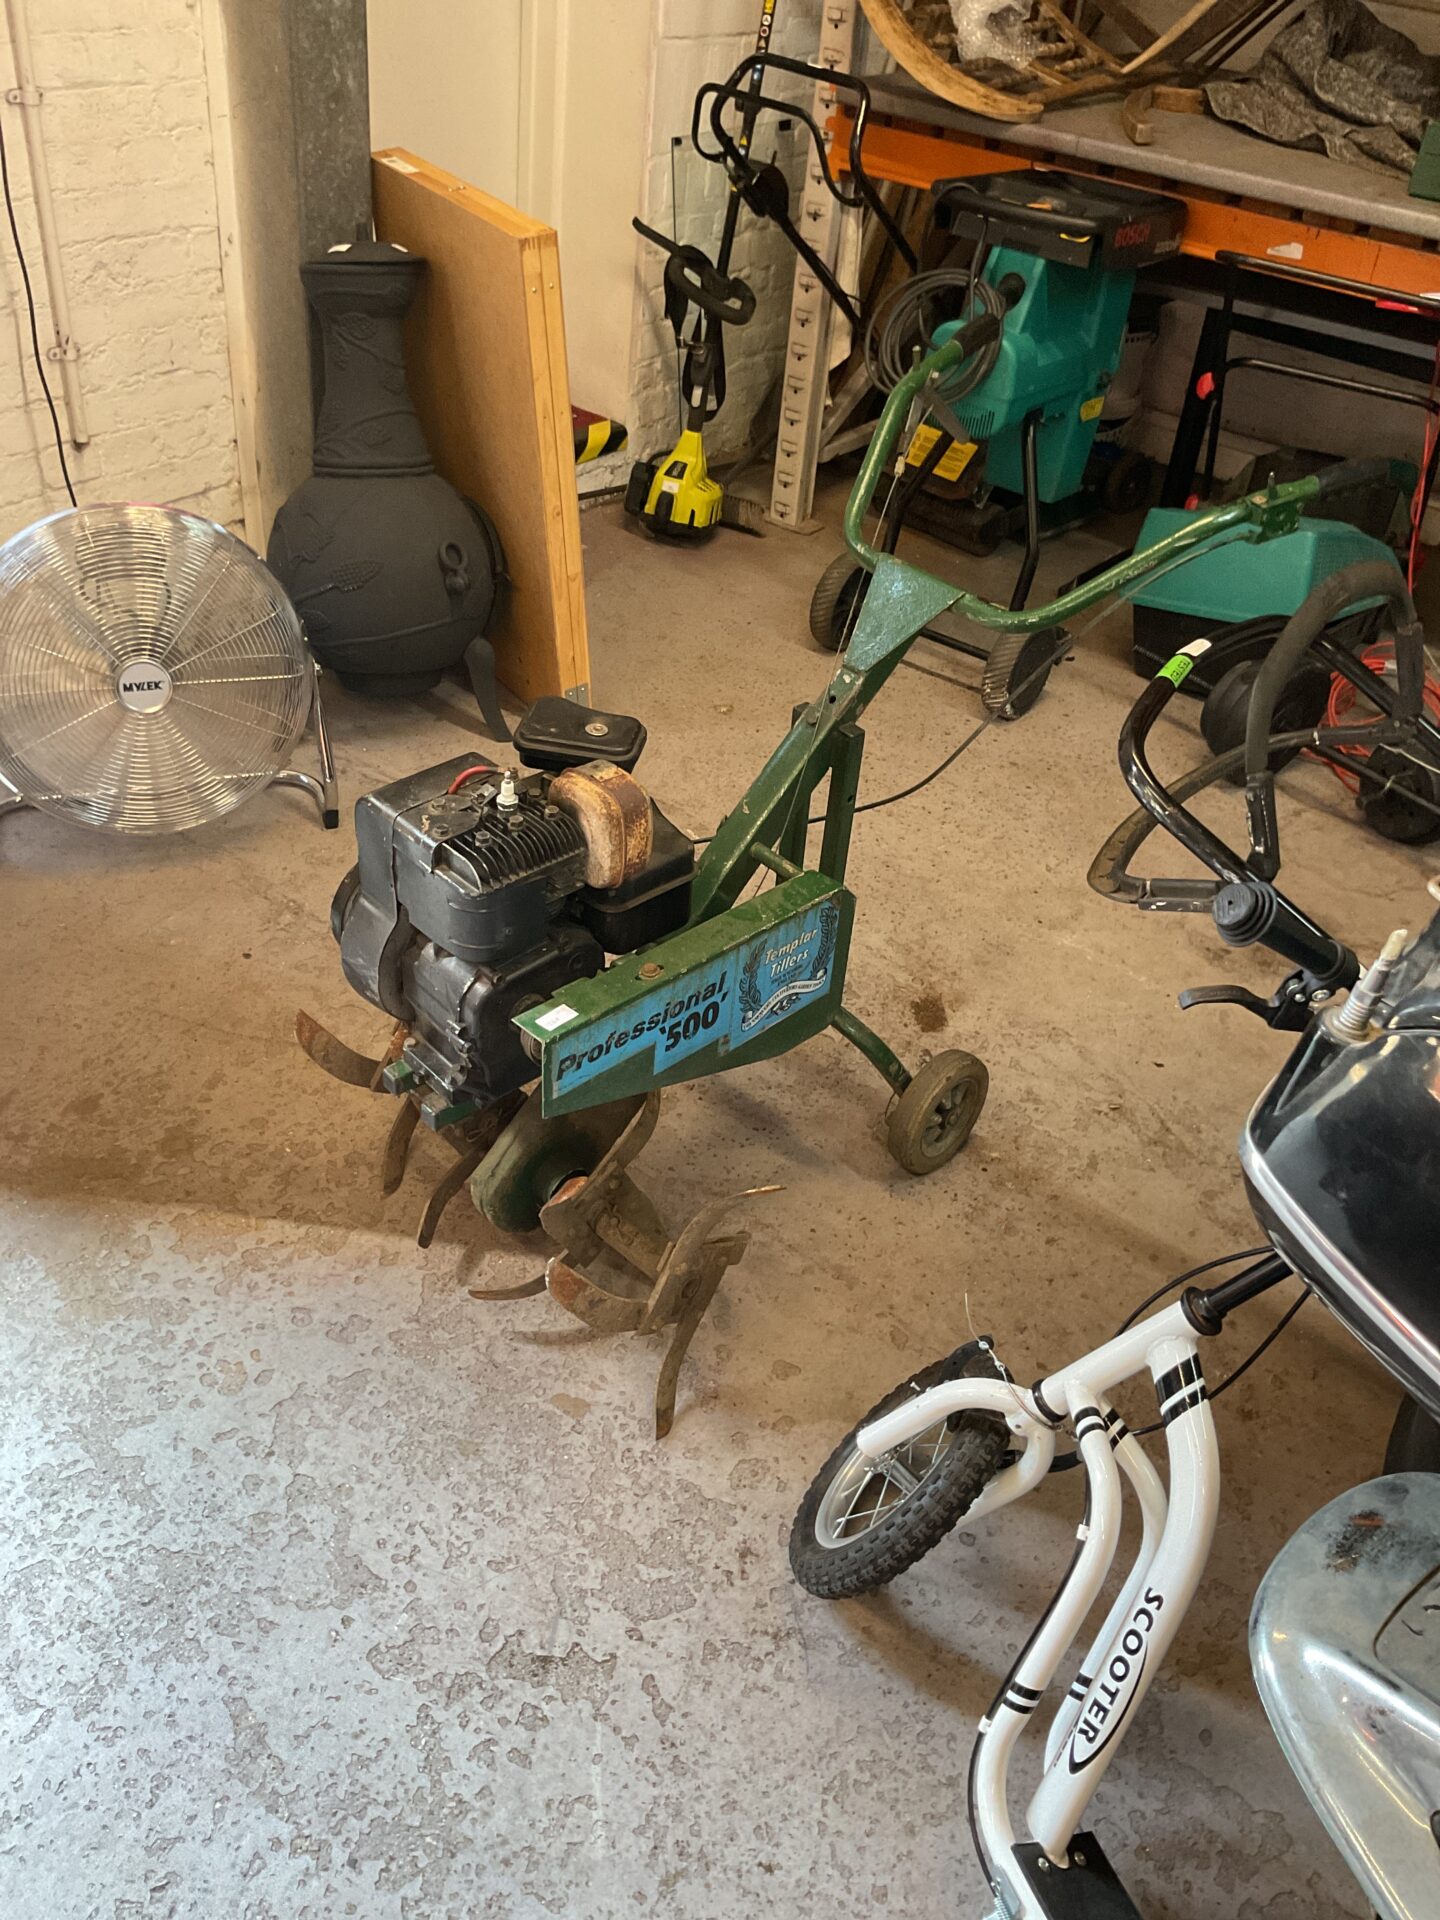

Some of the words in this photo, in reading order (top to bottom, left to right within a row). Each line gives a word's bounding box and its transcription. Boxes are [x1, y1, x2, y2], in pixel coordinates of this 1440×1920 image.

[123, 680, 163, 692] MYLEK
[765, 928, 818, 965] Templar
[770, 949, 809, 977] Tillers
[556, 970, 728, 1082] Professional
[1077, 1587, 1164, 1745] SCOOTER
